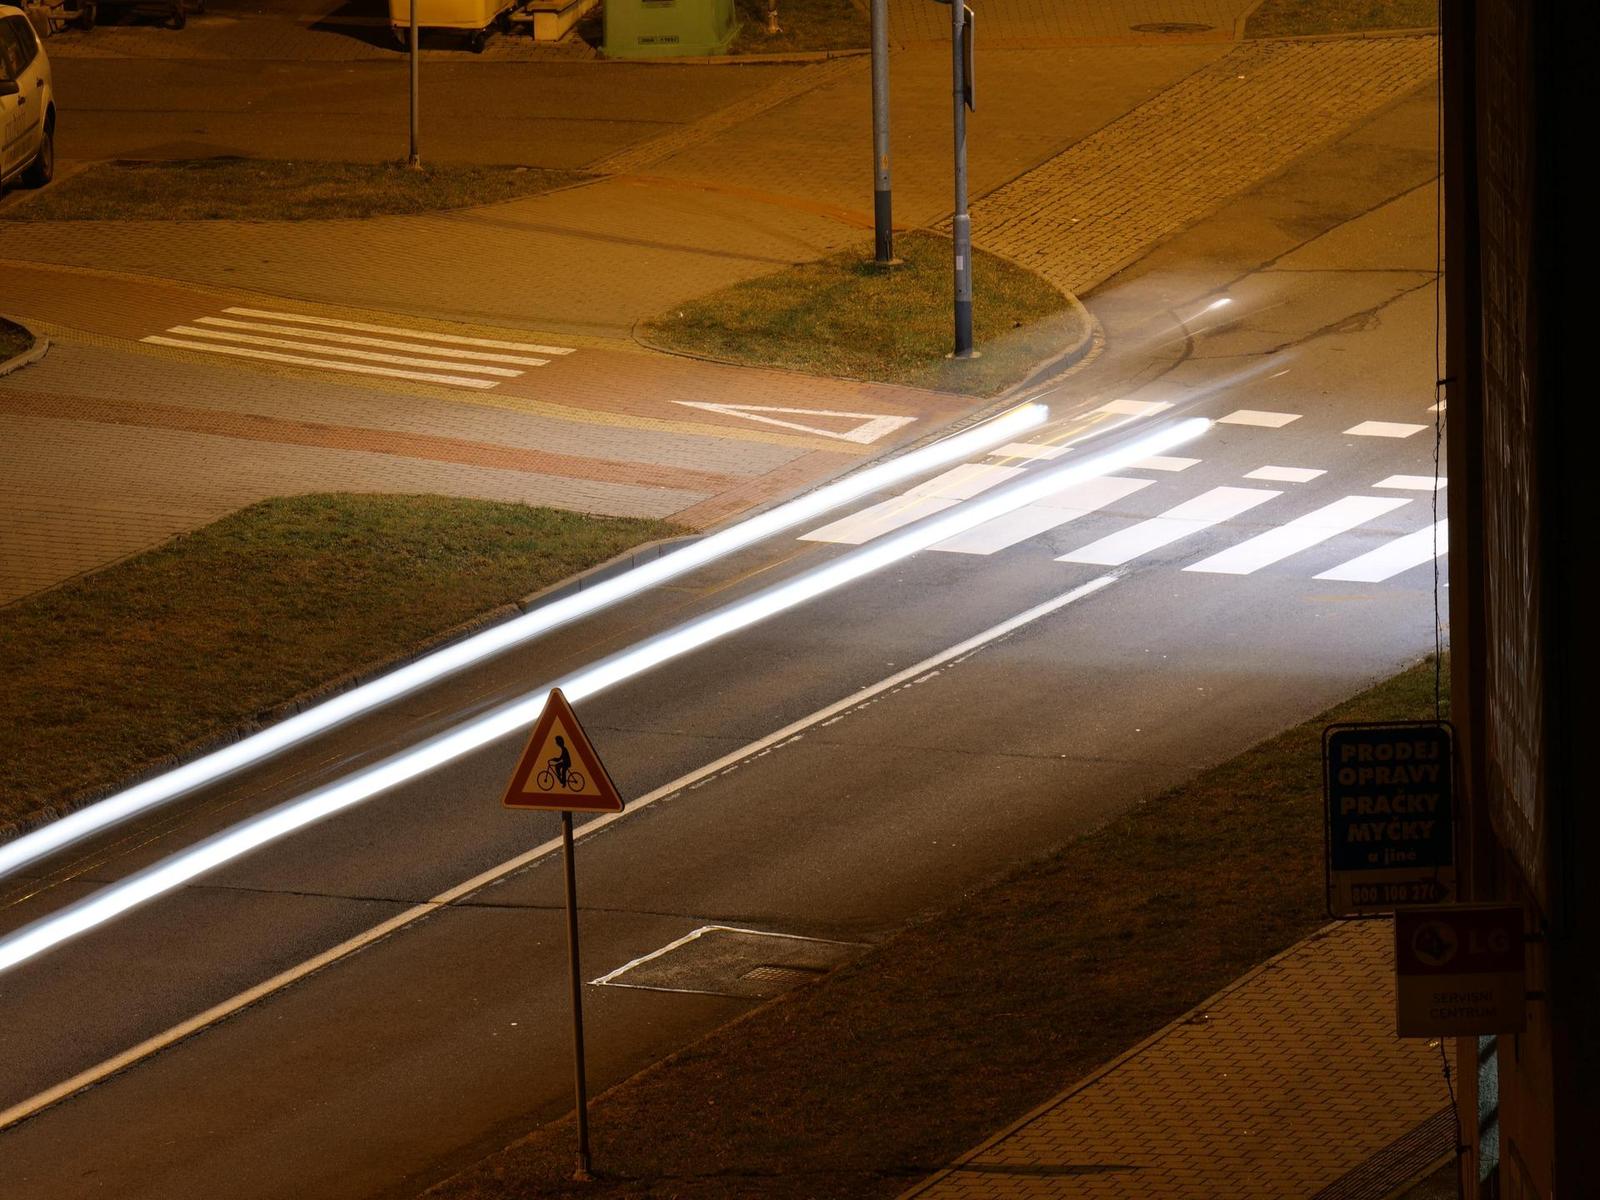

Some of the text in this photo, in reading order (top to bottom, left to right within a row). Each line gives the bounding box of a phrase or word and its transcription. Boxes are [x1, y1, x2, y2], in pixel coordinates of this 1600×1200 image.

[1341, 740, 1440, 762] PRODEJ
[1339, 764, 1440, 785] OPRAVY
[1340, 787, 1440, 815] PRAČKY
[1347, 816, 1436, 842] MYČKY
[1368, 848, 1417, 865] a jiné
[1468, 927, 1511, 954] LG
[1430, 1007, 1497, 1018] CENTRUM
